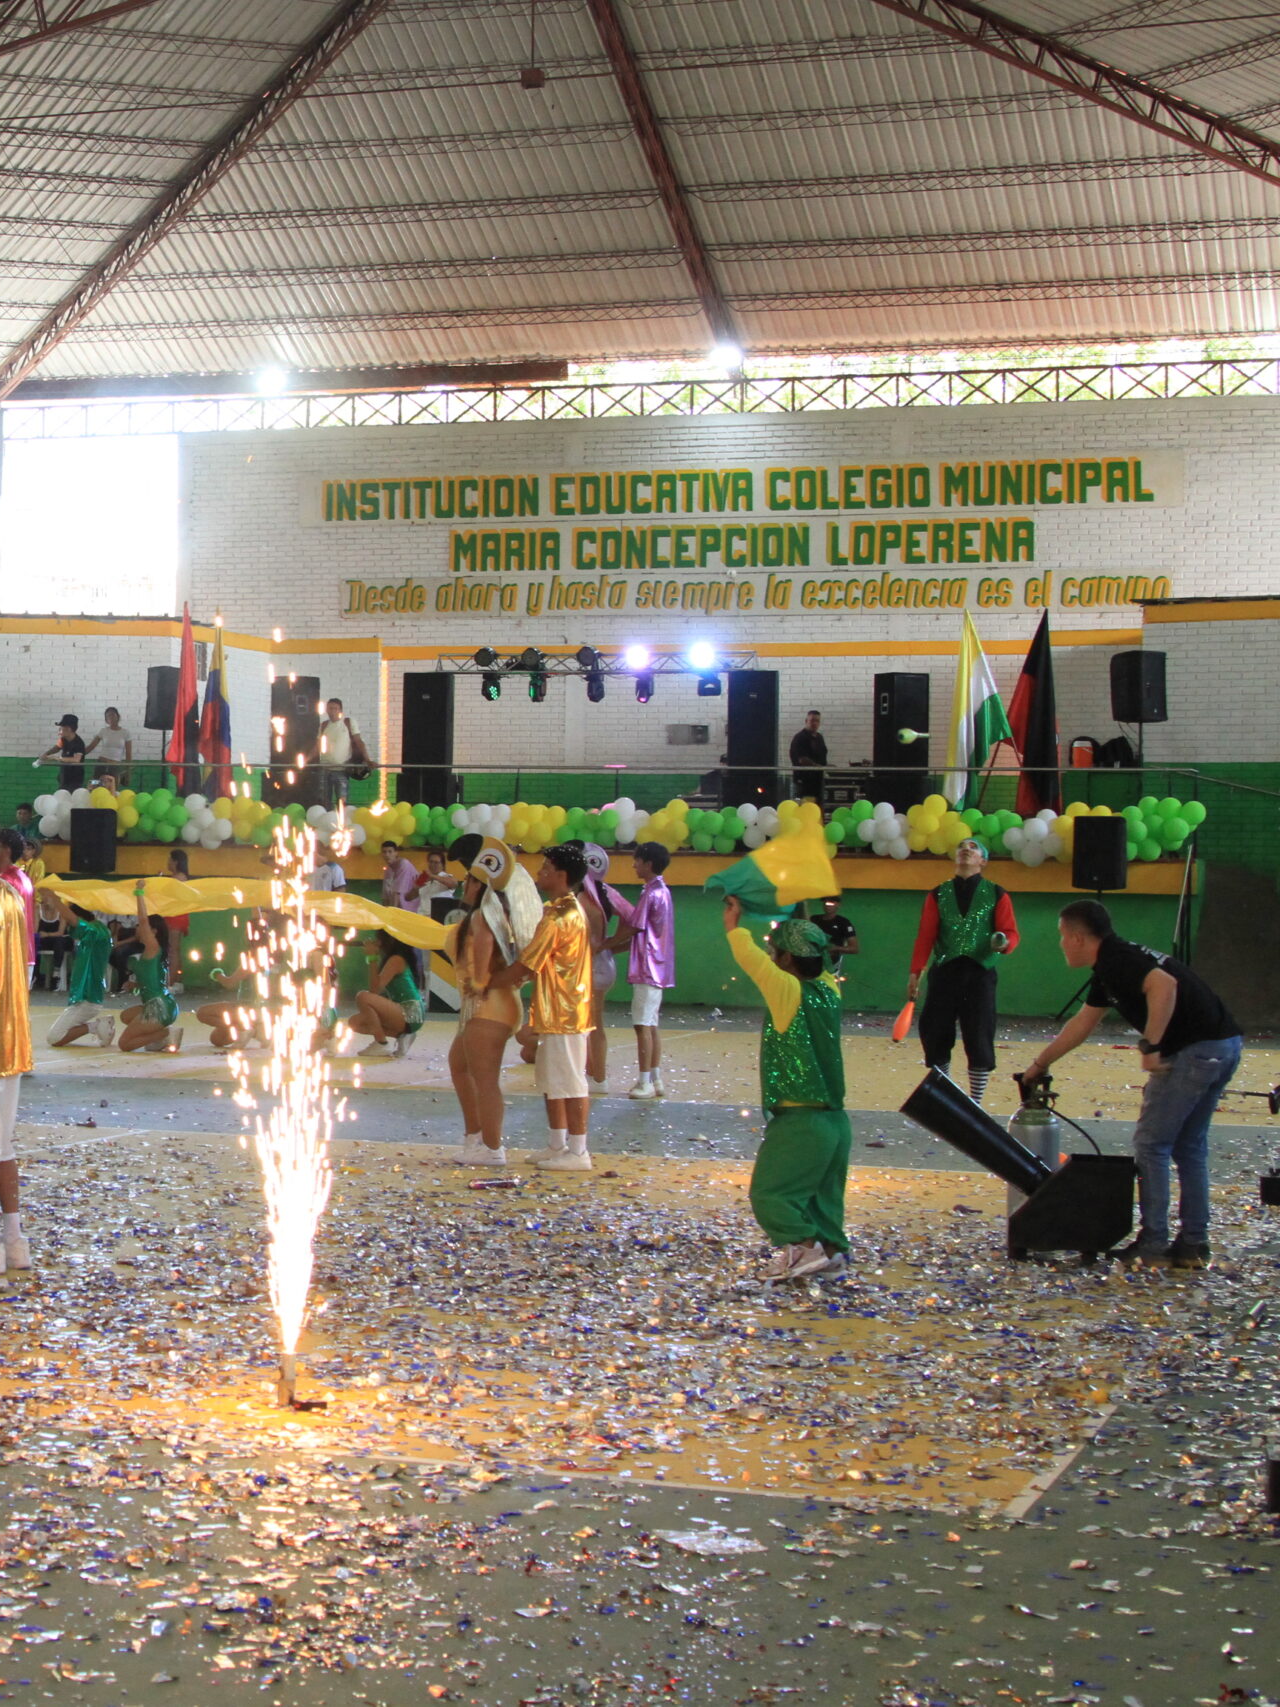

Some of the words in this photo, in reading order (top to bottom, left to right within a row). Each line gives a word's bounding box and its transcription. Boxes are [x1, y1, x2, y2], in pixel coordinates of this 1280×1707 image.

[322, 474, 539, 521] INSTITUCION
[549, 468, 753, 516] EDUCATIVA
[765, 464, 931, 511] COLEGIO
[938, 456, 1154, 507] MUNICIPAL
[449, 528, 560, 572] MARIA
[572, 523, 809, 569] CONCEPCION
[826, 517, 1034, 565] LOPERENA
[344, 578, 426, 615] Desde
[435, 577, 518, 613] ahora
[526, 580, 545, 616] y
[548, 574, 628, 611] hasta
[636, 578, 754, 615] siempre
[765, 573, 792, 610] la
[801, 572, 968, 608] excelencia
[977, 576, 1014, 608] es
[1025, 570, 1053, 608] el
[1060, 575, 1170, 608] camino
